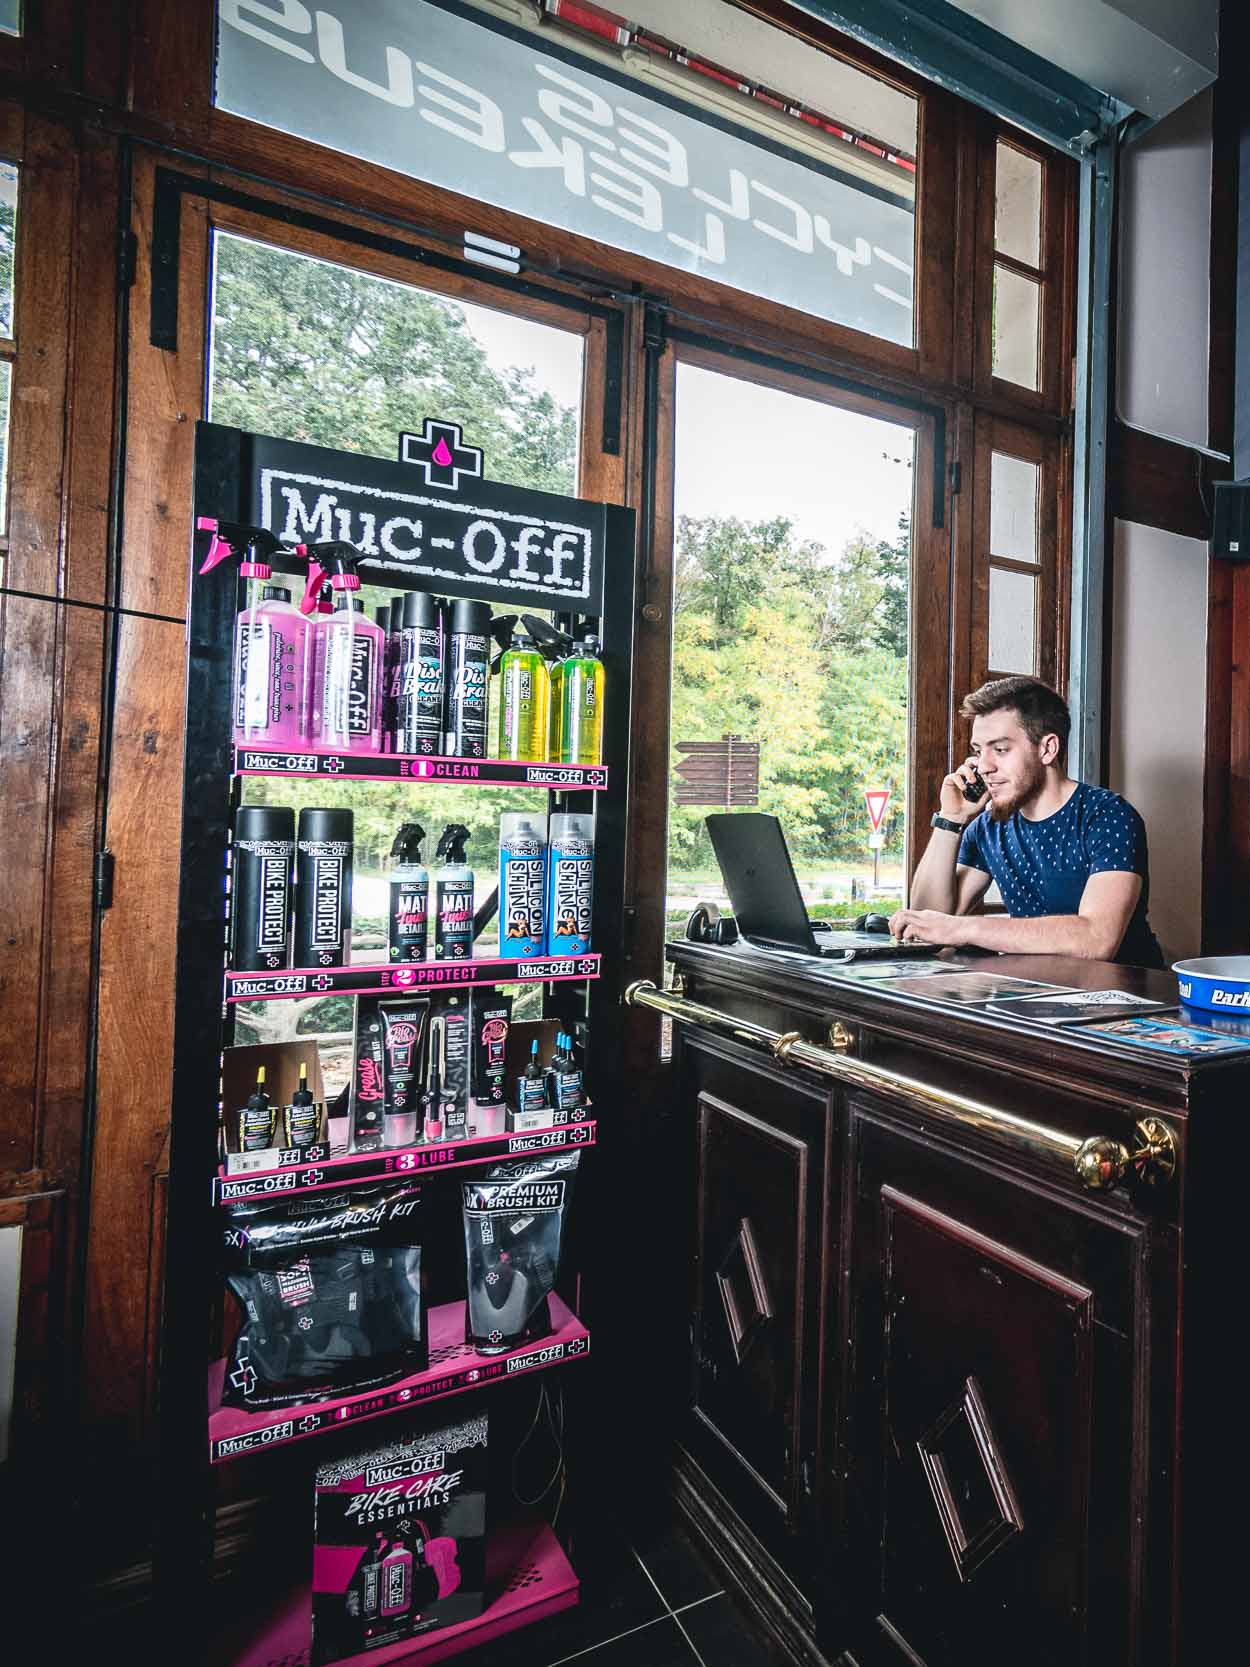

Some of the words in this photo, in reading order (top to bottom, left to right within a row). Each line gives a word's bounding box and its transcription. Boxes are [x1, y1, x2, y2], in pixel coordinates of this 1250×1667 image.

[280, 487, 578, 588] Muc-Off
[248, 755, 315, 772] Muc-Off
[436, 763, 479, 777] CLEAN
[530, 769, 582, 783] Muc-Off
[266, 860, 286, 888] BIKE
[319, 860, 338, 888] BIKE
[264, 890, 285, 943] PROTECT
[316, 889, 338, 941] PROTECT
[418, 967, 478, 982] PROTECT
[521, 963, 573, 976] Muc-Off
[236, 978, 304, 993] Muc-Off
[357, 1057, 385, 1101] Grease
[512, 1134, 564, 1150] Muc-Off
[422, 1151, 456, 1166] LUBE
[226, 1175, 294, 1197] Muc-Off
[492, 1184, 559, 1198] PREMIUM
[331, 1207, 386, 1229] BRUSH
[390, 1200, 421, 1220] KIT
[487, 1197, 533, 1209] BRUSH
[537, 1195, 559, 1207] KIT
[510, 1345, 563, 1371] Muc-Off
[222, 1423, 292, 1456] Muc-Off
[369, 1454, 441, 1484] Muc-Off
[344, 1486, 403, 1517] BIKE
[405, 1470, 464, 1498] CARE
[358, 1492, 450, 1526] ESSENTIALS
